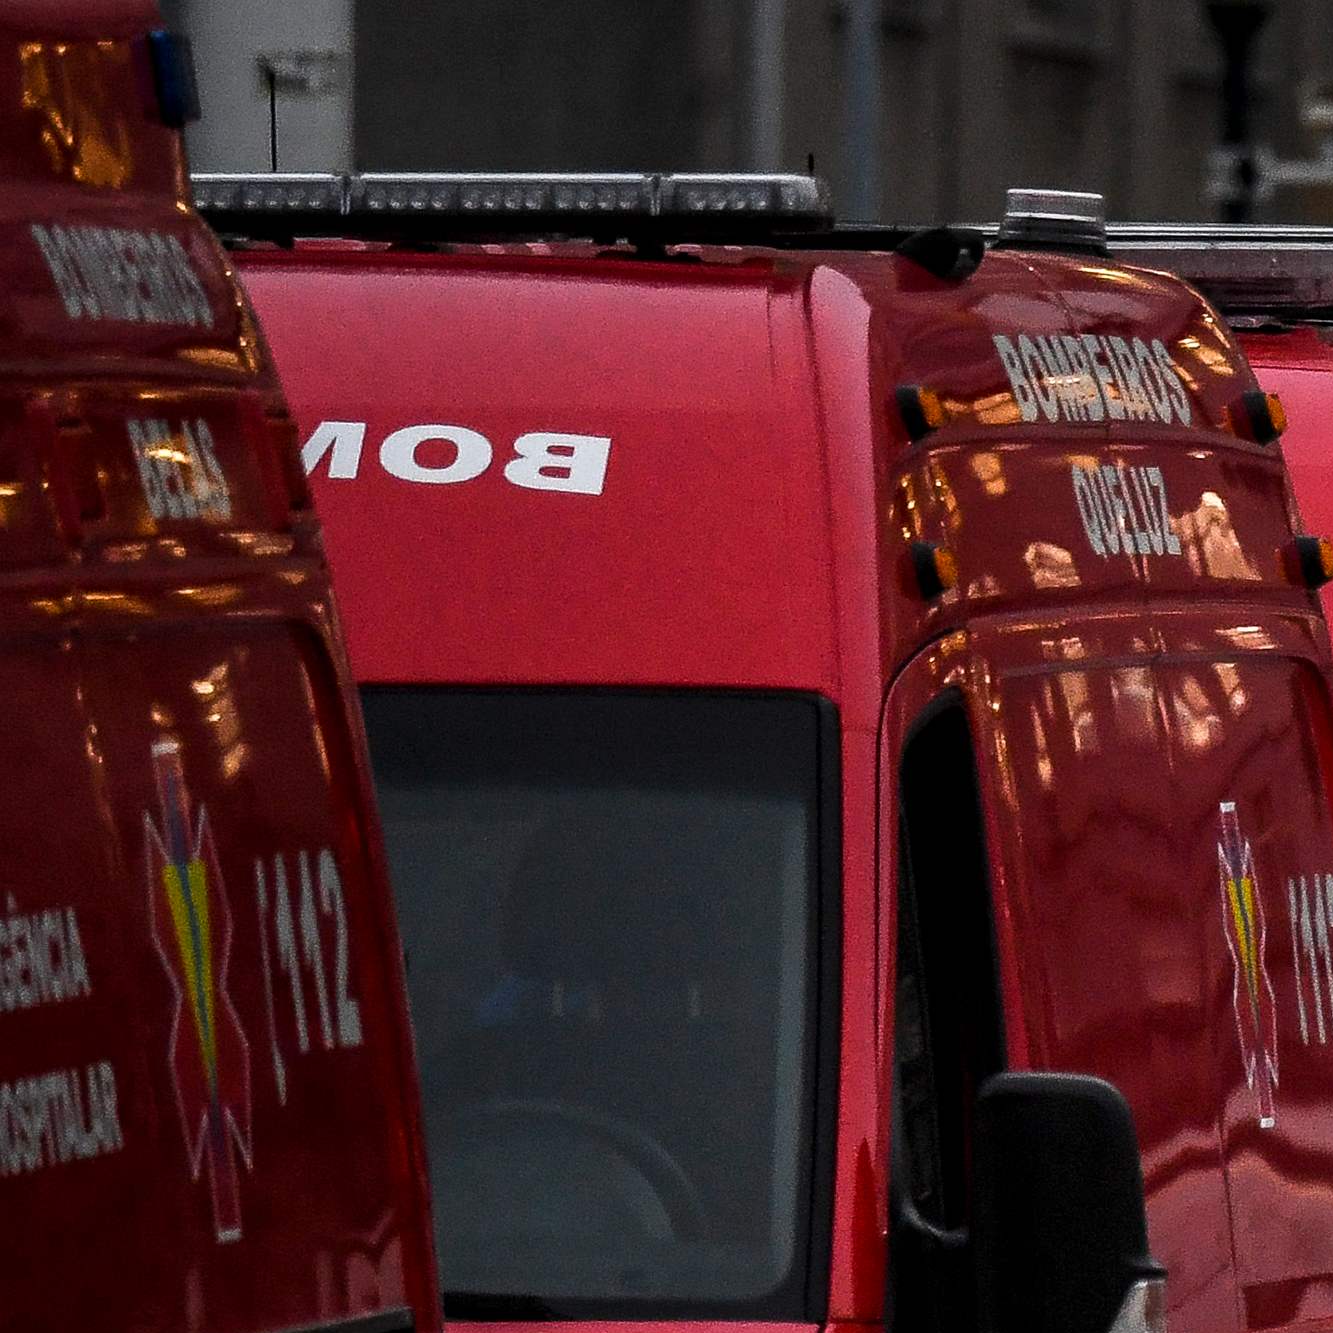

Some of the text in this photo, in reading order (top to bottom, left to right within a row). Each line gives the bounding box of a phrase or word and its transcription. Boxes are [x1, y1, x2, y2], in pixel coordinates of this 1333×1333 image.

[992, 333, 1192, 427] BOMBEIROS
[1072, 465, 1181, 557] QUELUZ
[274, 848, 363, 1055] 112
